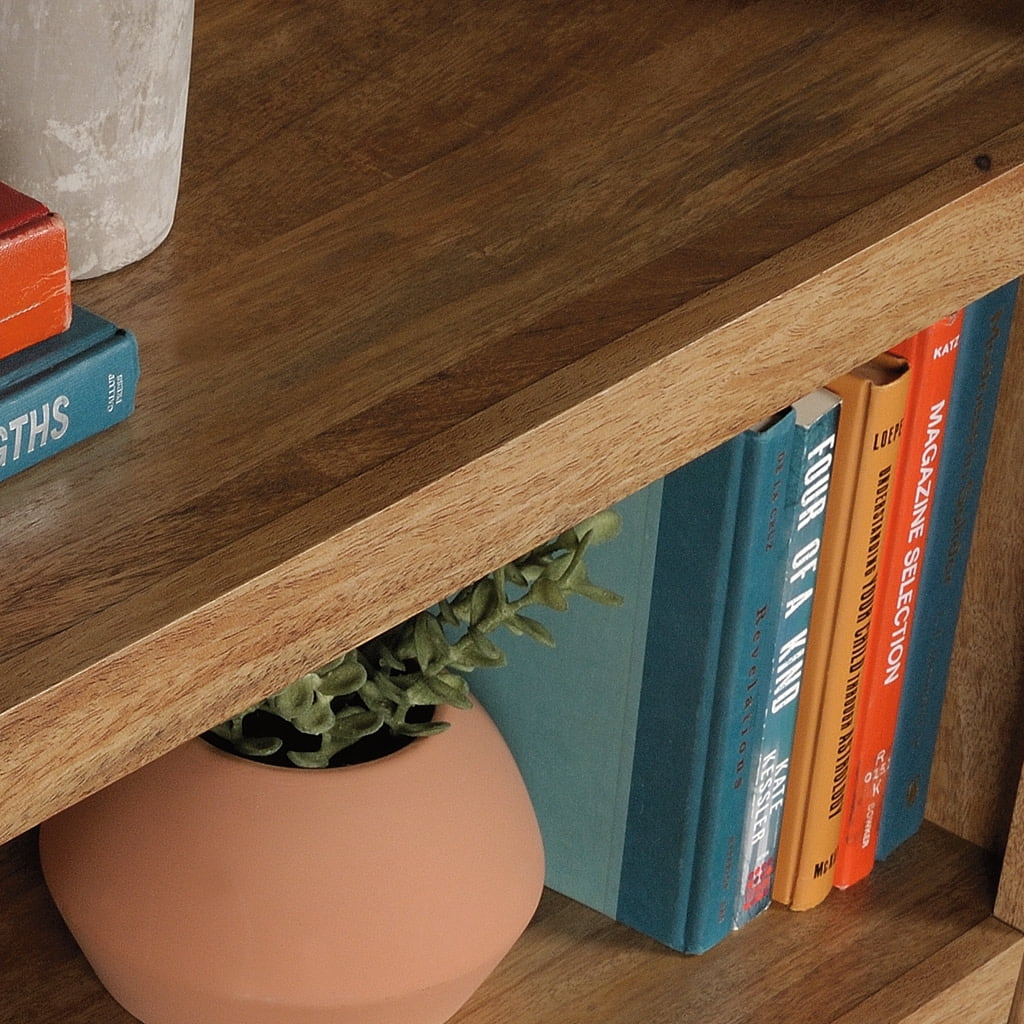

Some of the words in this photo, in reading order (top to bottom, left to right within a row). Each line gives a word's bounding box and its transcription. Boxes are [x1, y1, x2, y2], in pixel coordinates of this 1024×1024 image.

[933, 334, 960, 360] KATZ
[797, 433, 836, 532] FOUR
[907, 399, 946, 544] MAGAZINE
[790, 538, 821, 584] OF
[864, 464, 892, 577] UNDERSTANDING
[784, 587, 814, 619] A
[856, 574, 878, 624] YOUR
[884, 547, 920, 686] SELECTION
[771, 627, 809, 714] KIND
[849, 622, 871, 673] CHILD
[734, 604, 768, 789] Revelations
[840, 673, 861, 731] THROUGH
[751, 748, 777, 845] KESSLER
[769, 757, 790, 815] KATE
[828, 730, 855, 820] ASTROLOGY
